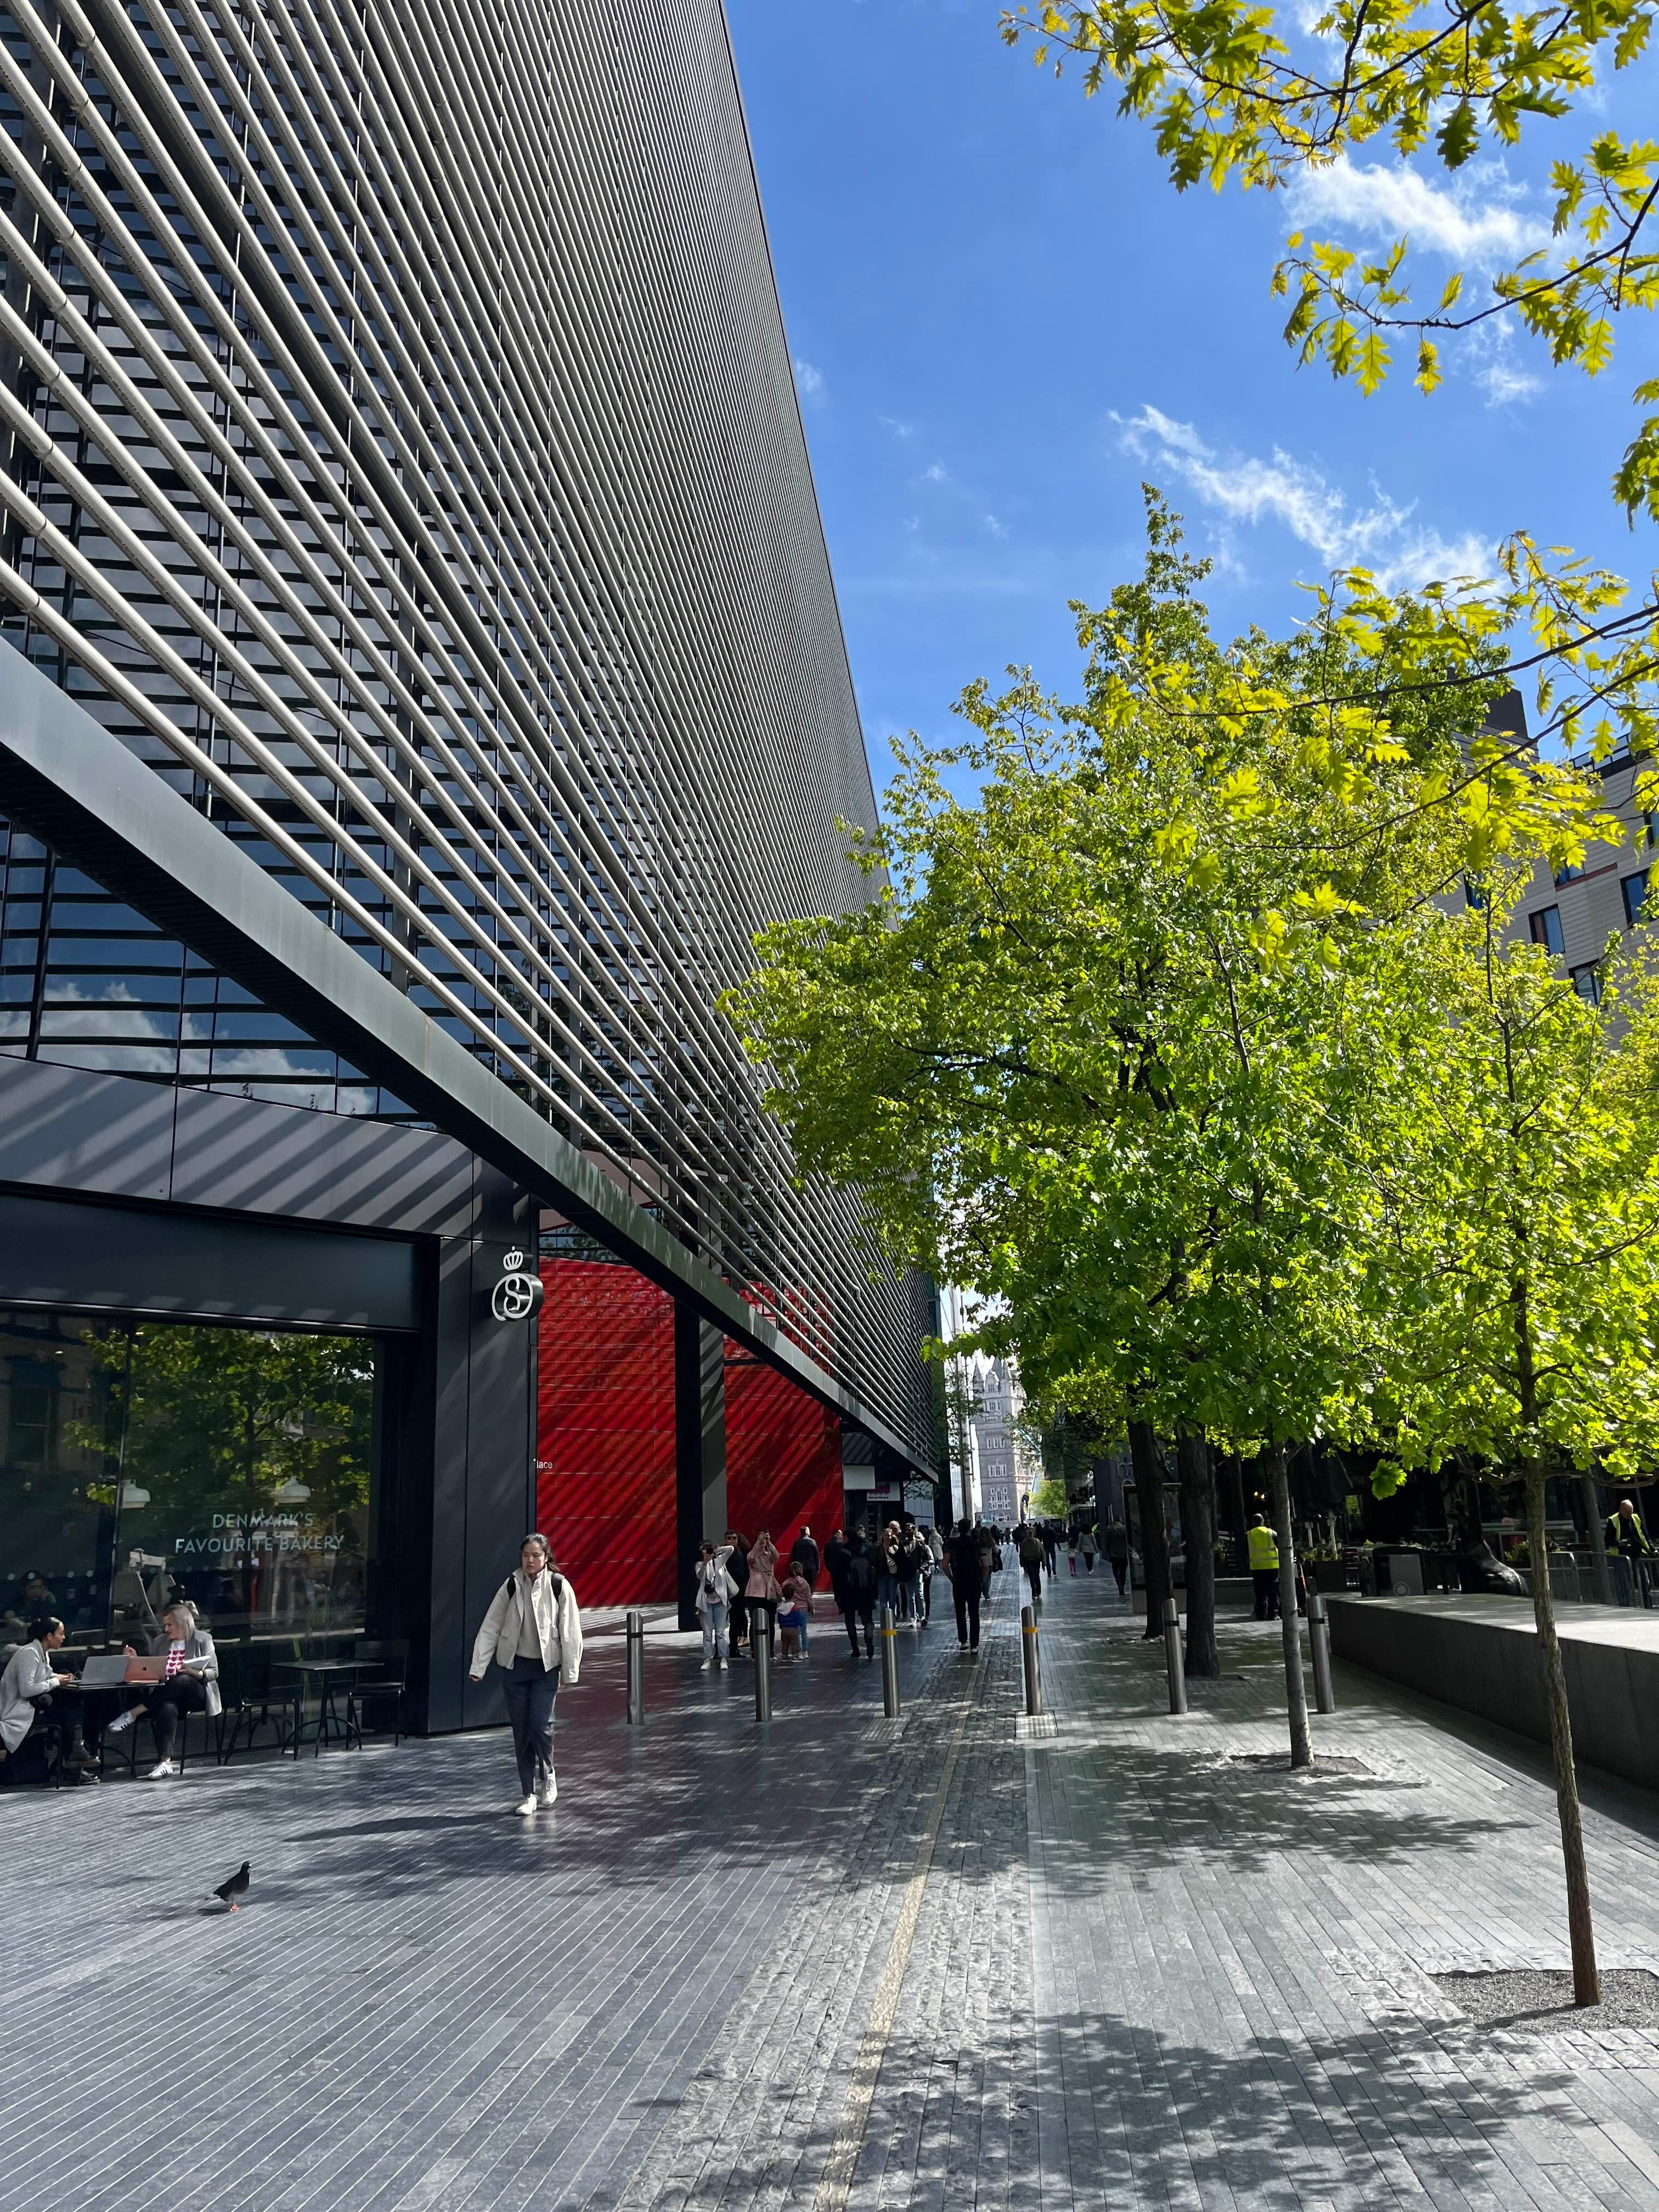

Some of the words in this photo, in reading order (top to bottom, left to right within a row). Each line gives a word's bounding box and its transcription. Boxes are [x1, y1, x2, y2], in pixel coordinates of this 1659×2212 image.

[537, 1460, 553, 1469] lace
[212, 1513, 313, 1528] DENMARK'S
[175, 1537, 273, 1554] FAVOURITE
[279, 1535, 344, 1551] BAKERY
